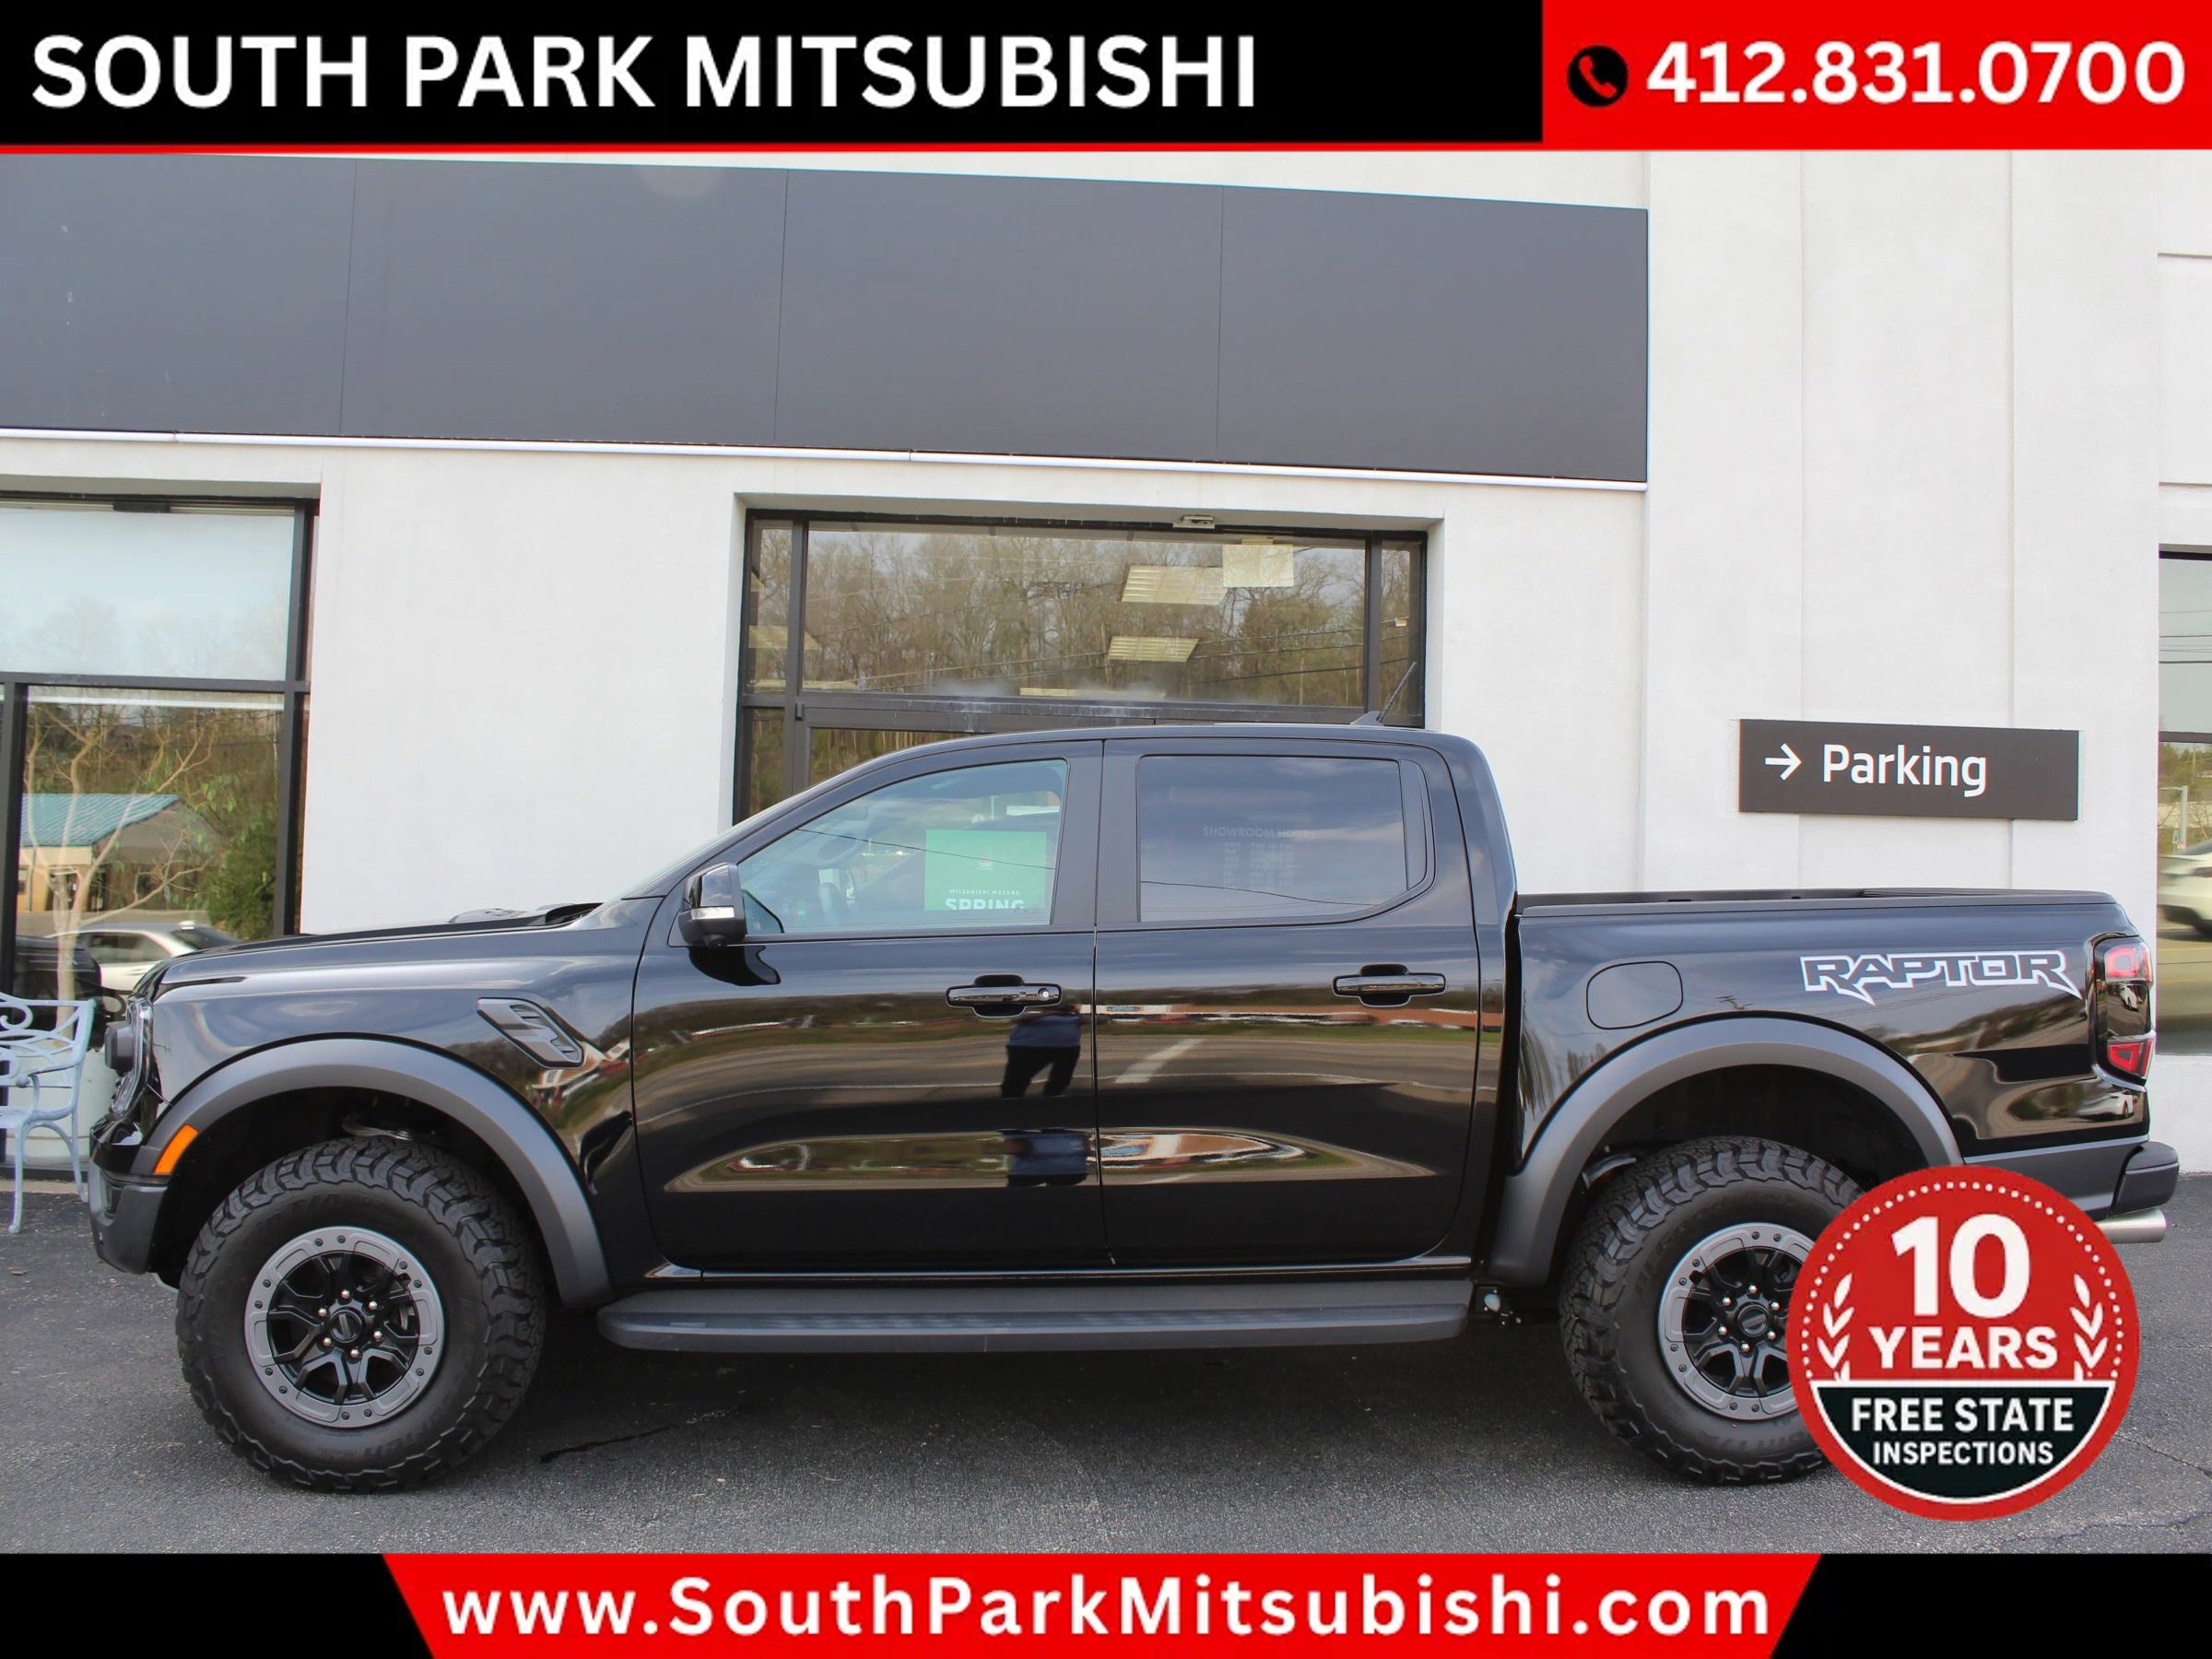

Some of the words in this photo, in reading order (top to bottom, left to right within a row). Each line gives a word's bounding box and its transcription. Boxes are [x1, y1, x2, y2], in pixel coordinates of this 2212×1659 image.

[1822, 742, 1988, 798] Parking
[1202, 826, 1275, 838] SHOWROOM
[1800, 949, 2083, 1006] RAPTOR
